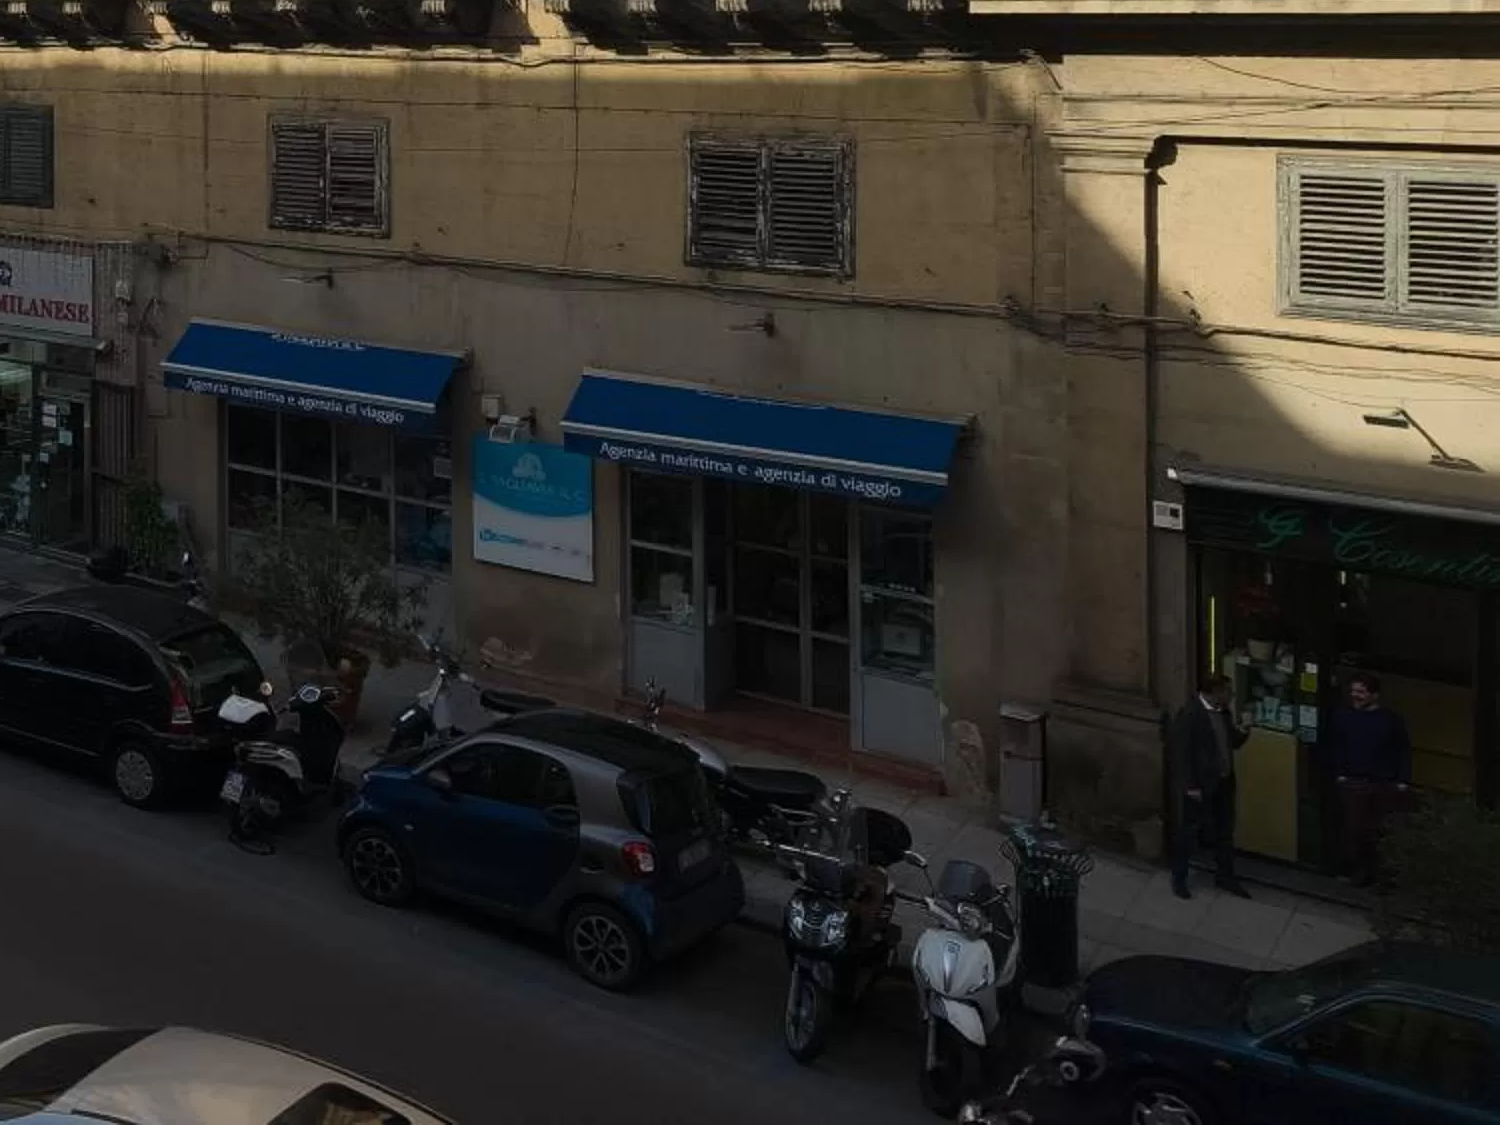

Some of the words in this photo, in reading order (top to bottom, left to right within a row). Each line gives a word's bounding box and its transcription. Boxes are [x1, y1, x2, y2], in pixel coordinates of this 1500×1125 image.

[231, 385, 286, 405] marittima
[297, 396, 343, 415] agenzia
[359, 405, 405, 425] viaggio
[598, 441, 656, 462] Agenzia
[660, 451, 734, 474] marittima
[737, 463, 748, 476] e
[753, 465, 816, 486] agenzia
[821, 472, 837, 489] di
[839, 476, 902, 499] viaggio
